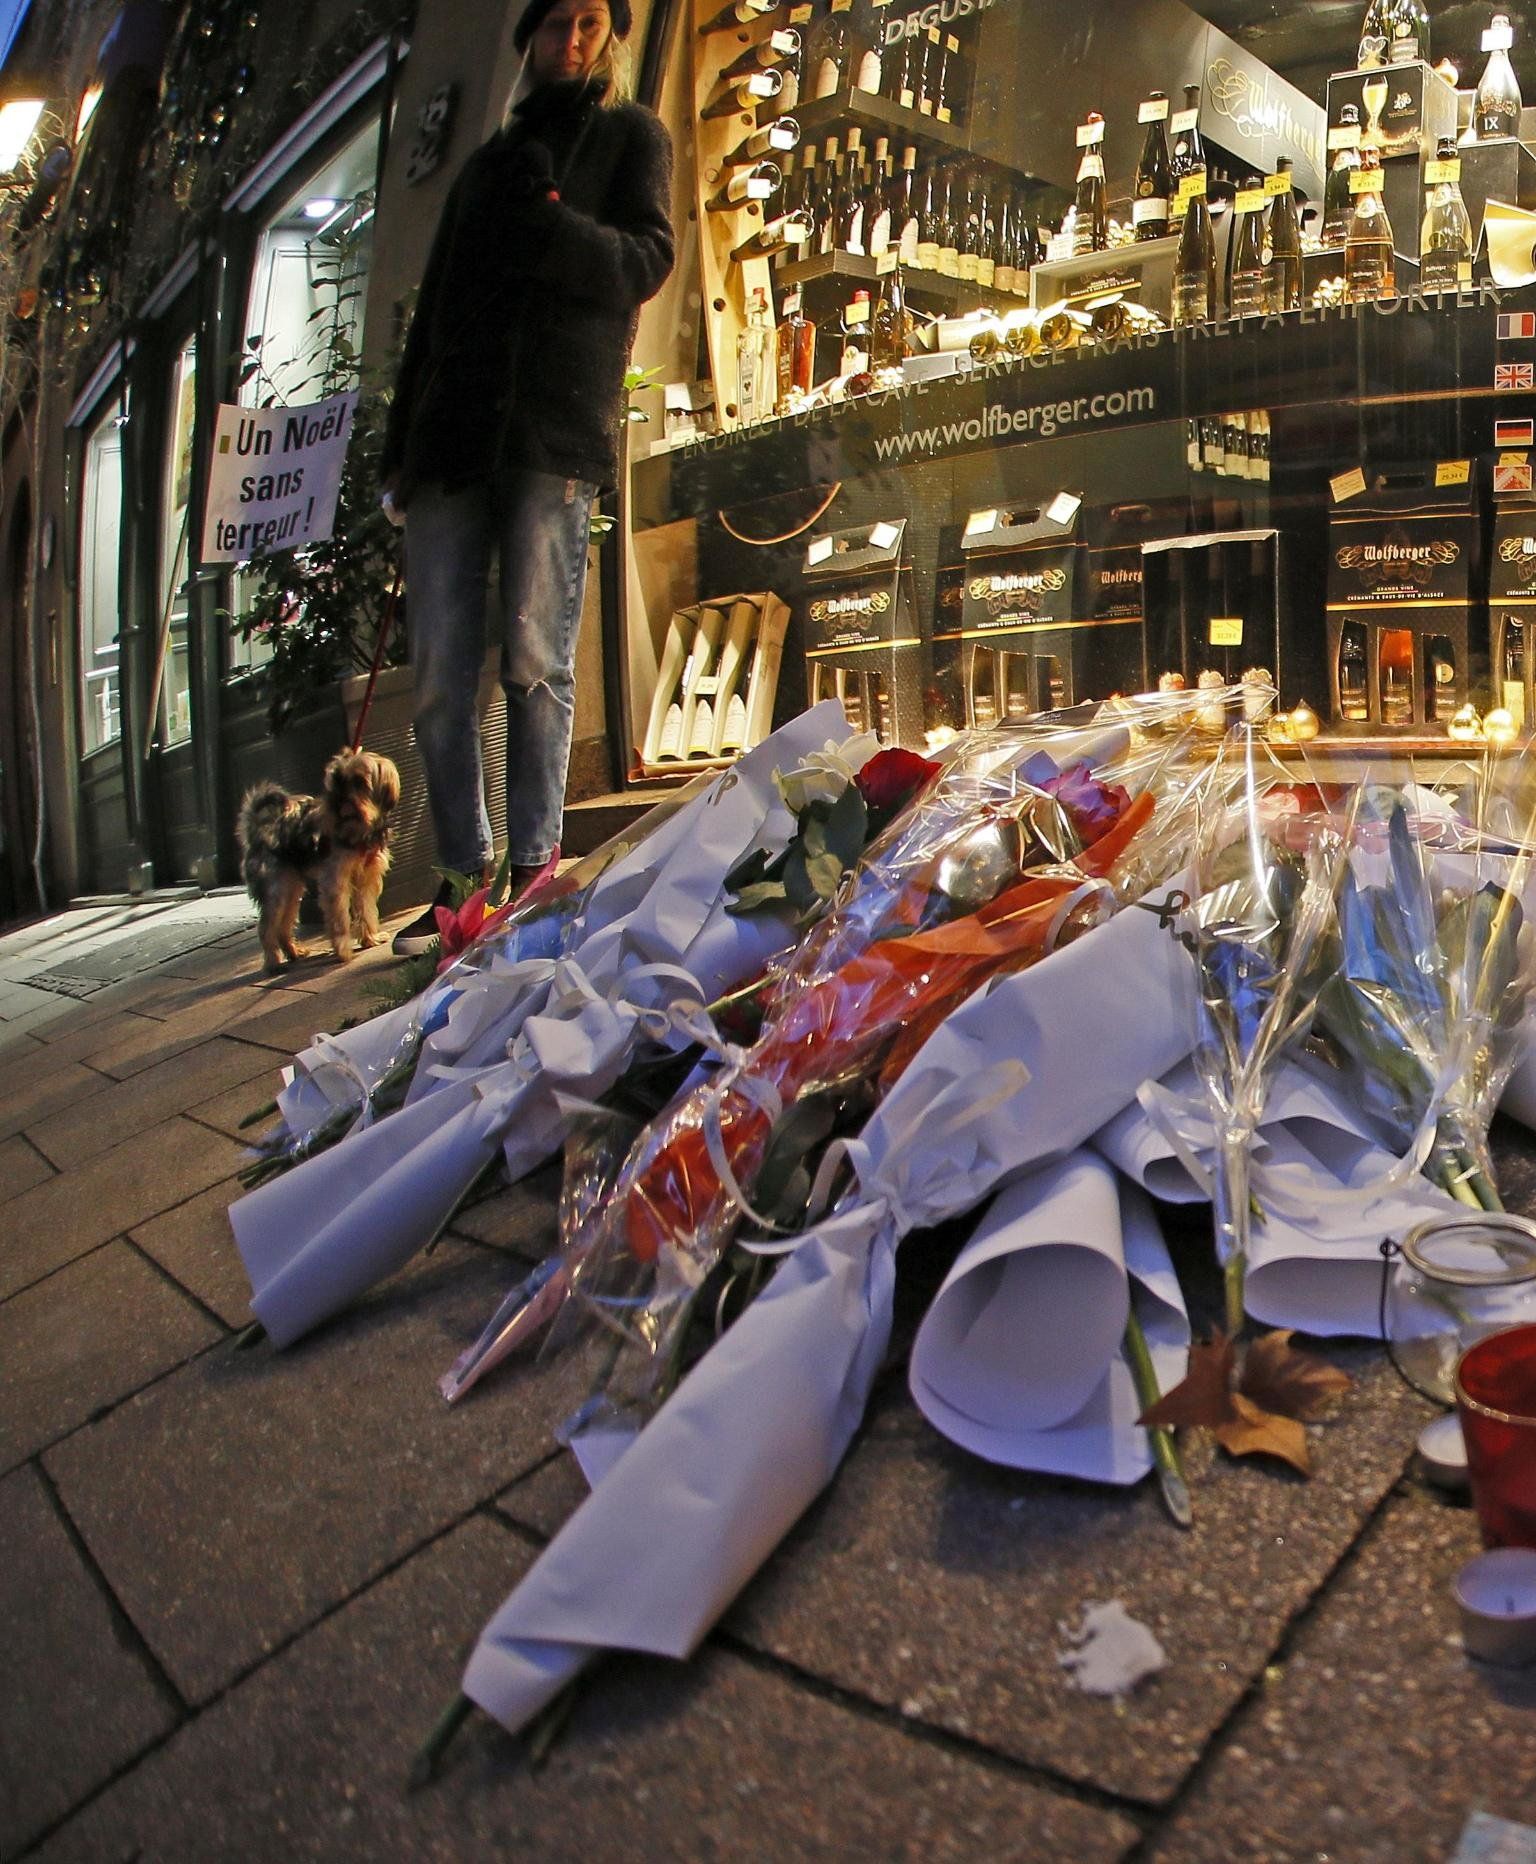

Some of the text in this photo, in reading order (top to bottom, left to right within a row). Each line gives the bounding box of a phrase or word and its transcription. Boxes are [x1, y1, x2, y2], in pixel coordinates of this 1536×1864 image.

[885, 0, 997, 46] DEGUS
[1484, 116, 1499, 131] IX
[1299, 276, 1502, 325] EMPORTER
[236, 402, 348, 456] Un Noël
[874, 386, 1155, 460] www.wolfberger.com
[239, 467, 305, 503] sans
[1364, 544, 1431, 562] Wolfberger
